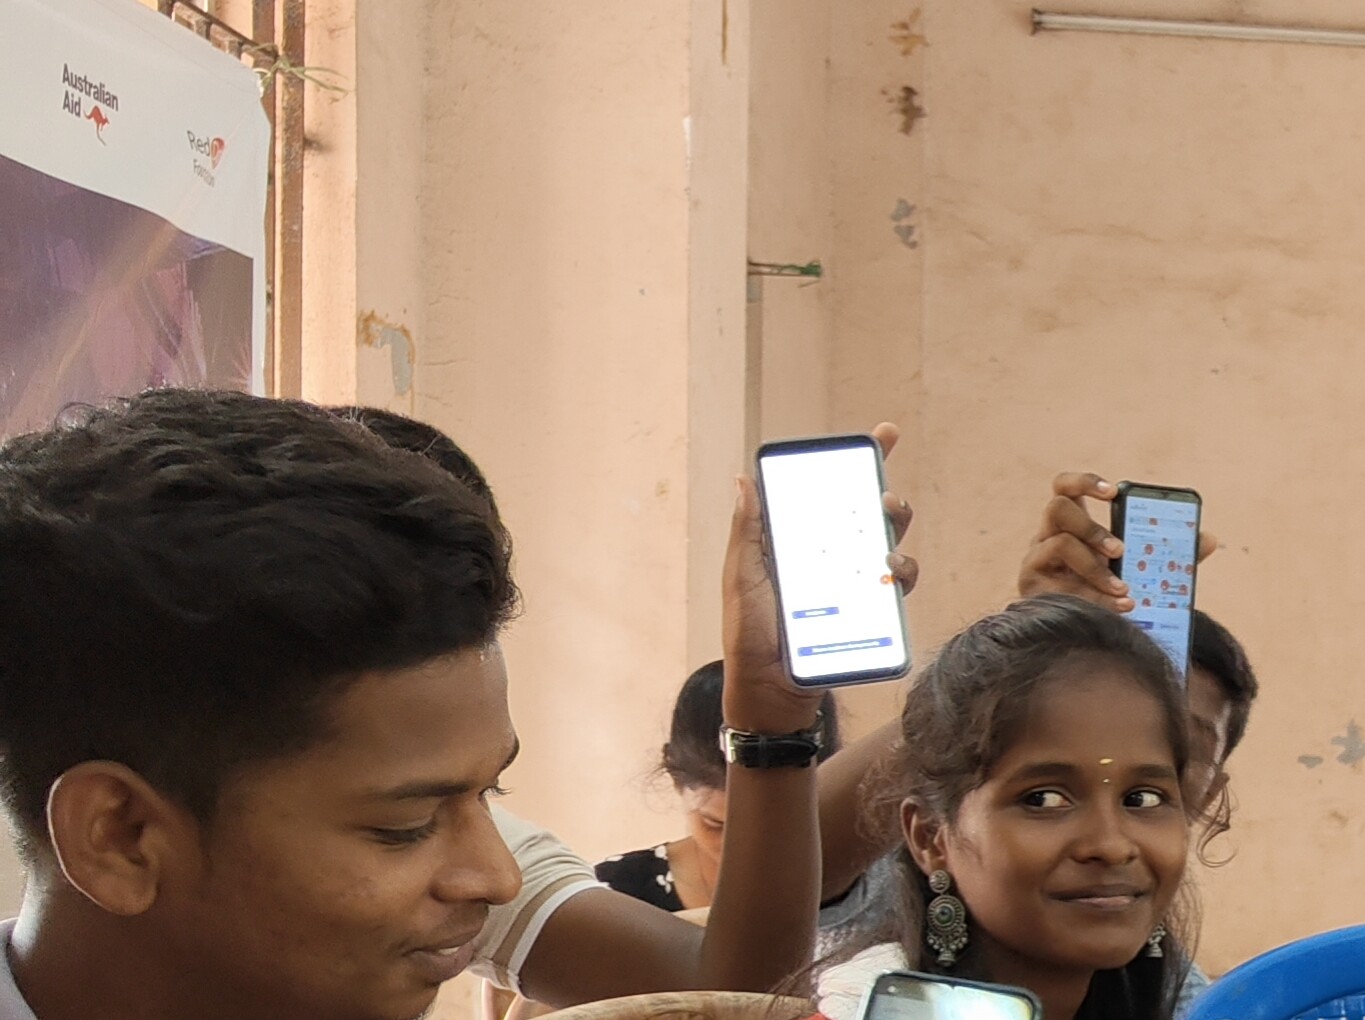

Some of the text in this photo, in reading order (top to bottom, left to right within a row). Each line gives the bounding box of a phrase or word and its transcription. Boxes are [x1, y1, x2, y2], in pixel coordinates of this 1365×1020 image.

[62, 63, 119, 111] Australian
[62, 90, 81, 118] Aid
[187, 130, 210, 157] Red
